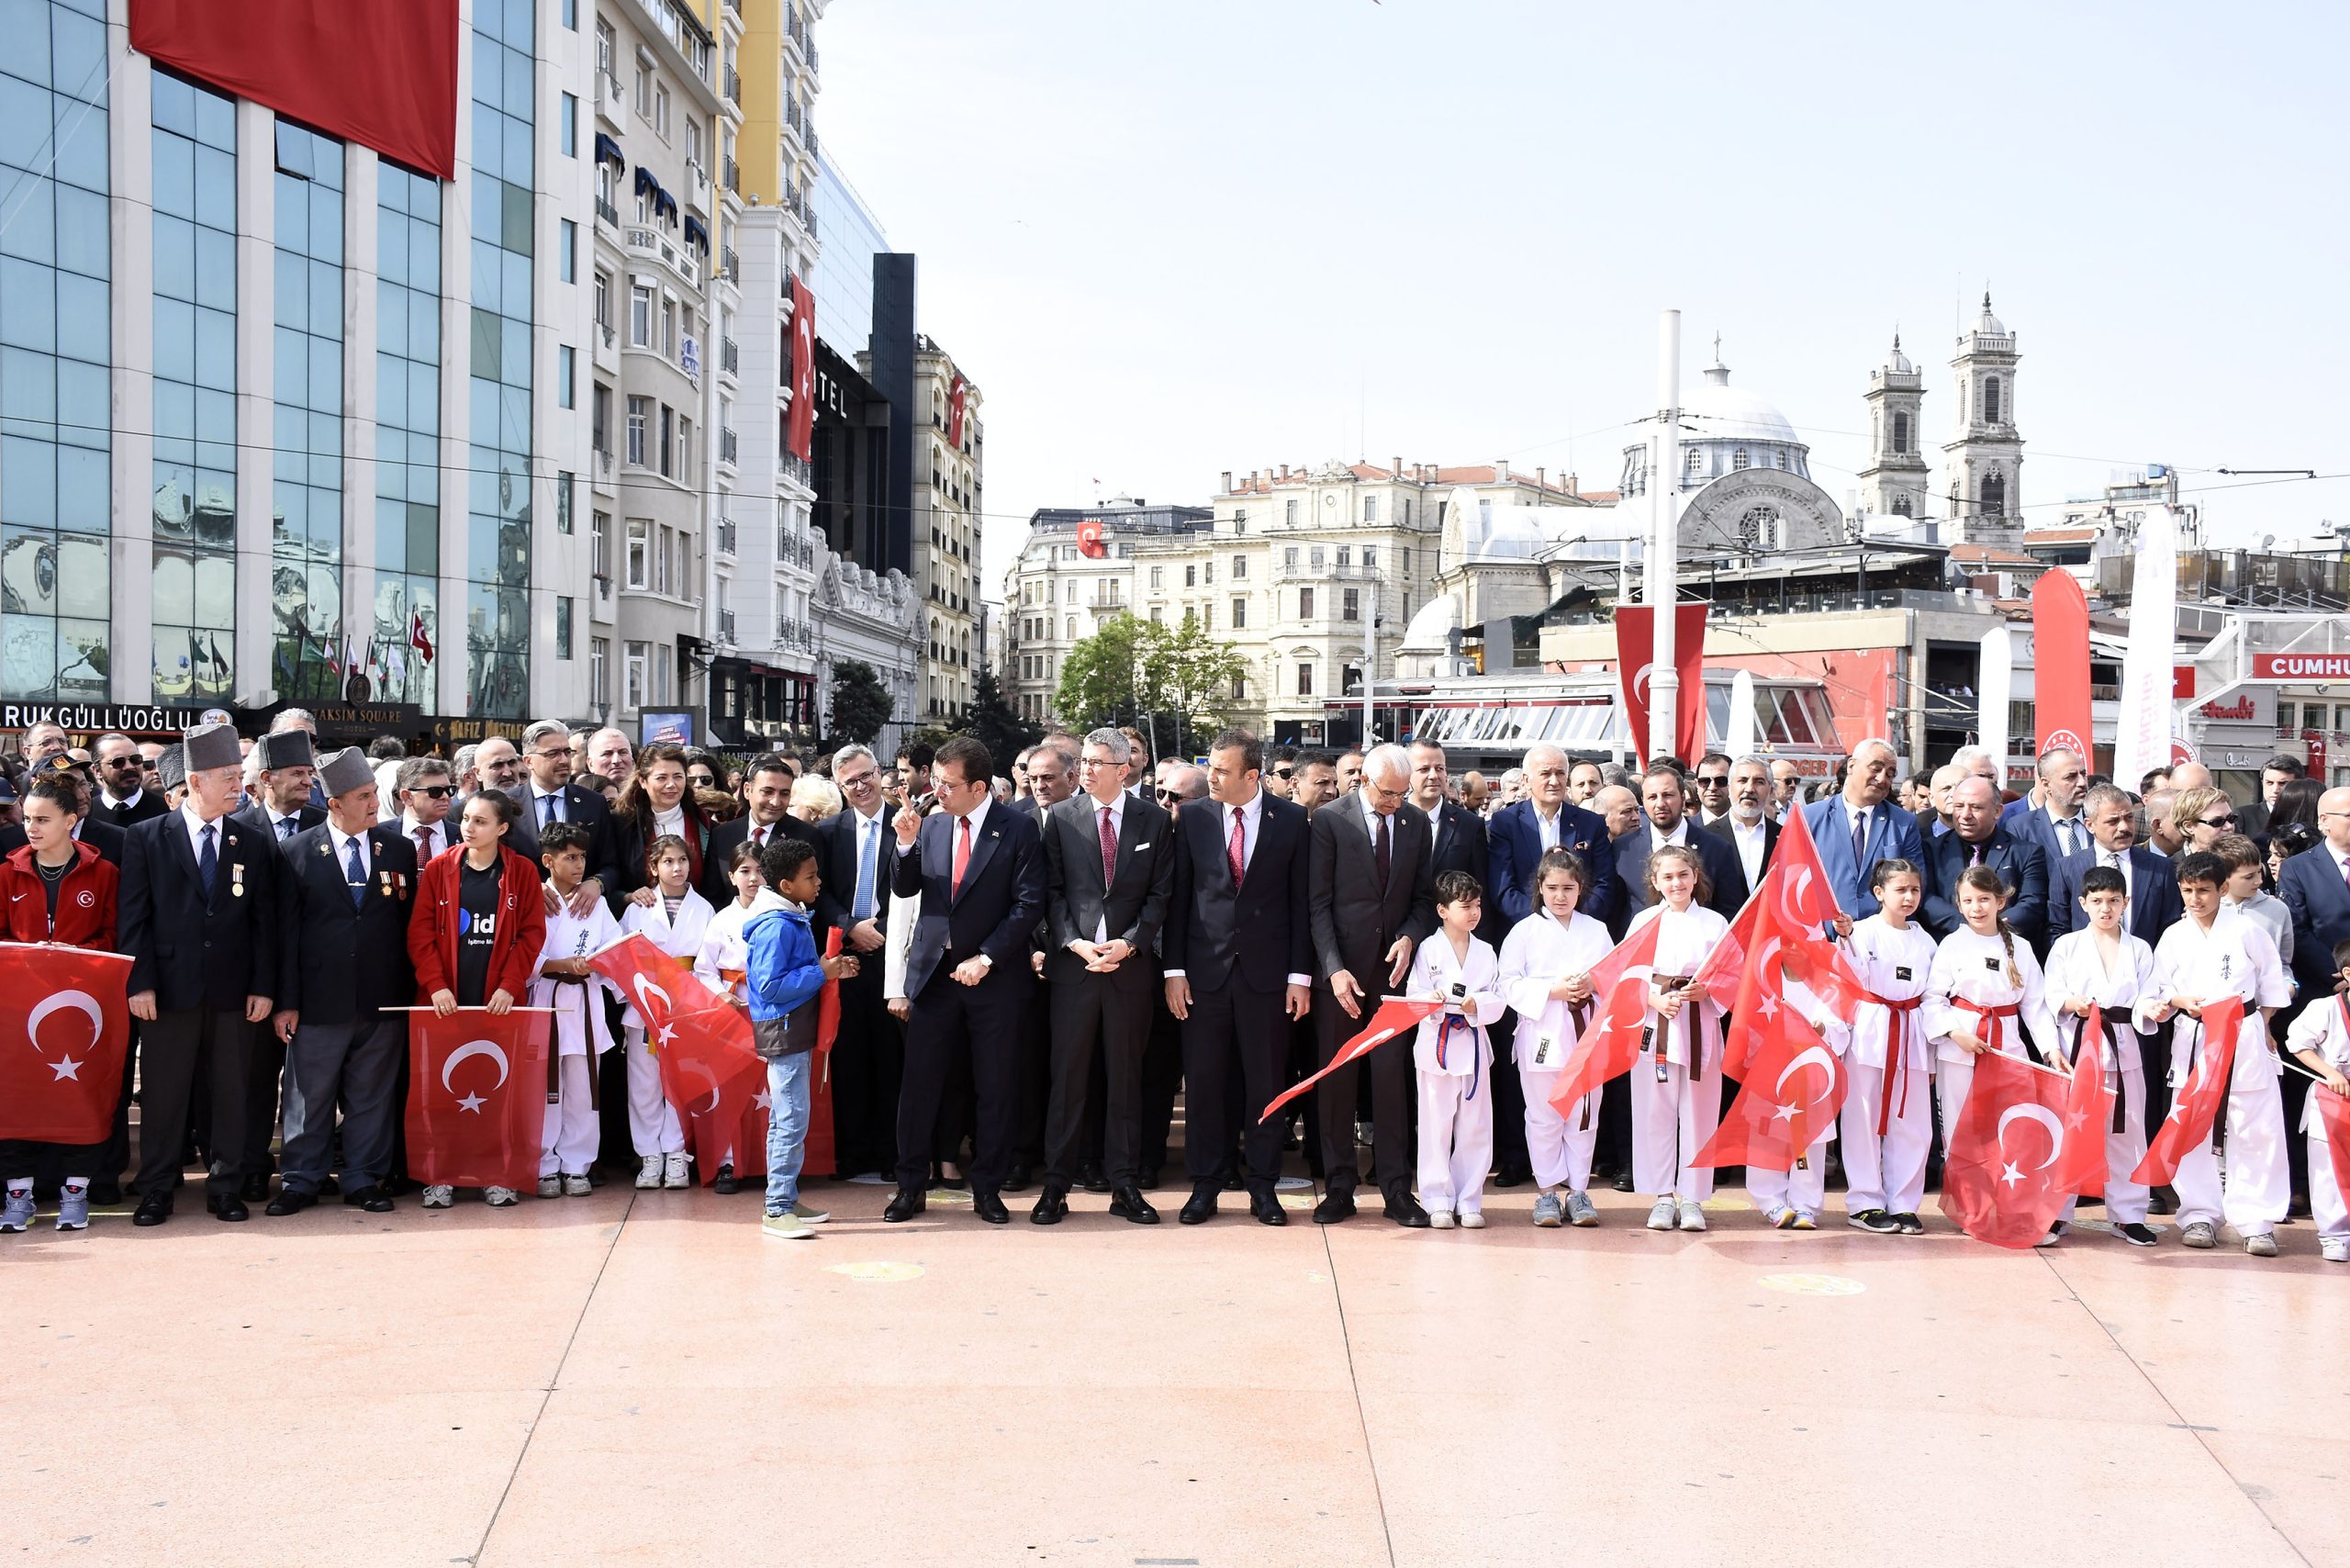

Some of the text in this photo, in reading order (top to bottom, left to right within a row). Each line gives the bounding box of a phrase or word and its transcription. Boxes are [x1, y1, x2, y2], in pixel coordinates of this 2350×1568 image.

[0, 705, 54, 727] RUK
[58, 702, 191, 731] GÜLLÜOĞLU
[360, 709, 403, 723] SQUARE
